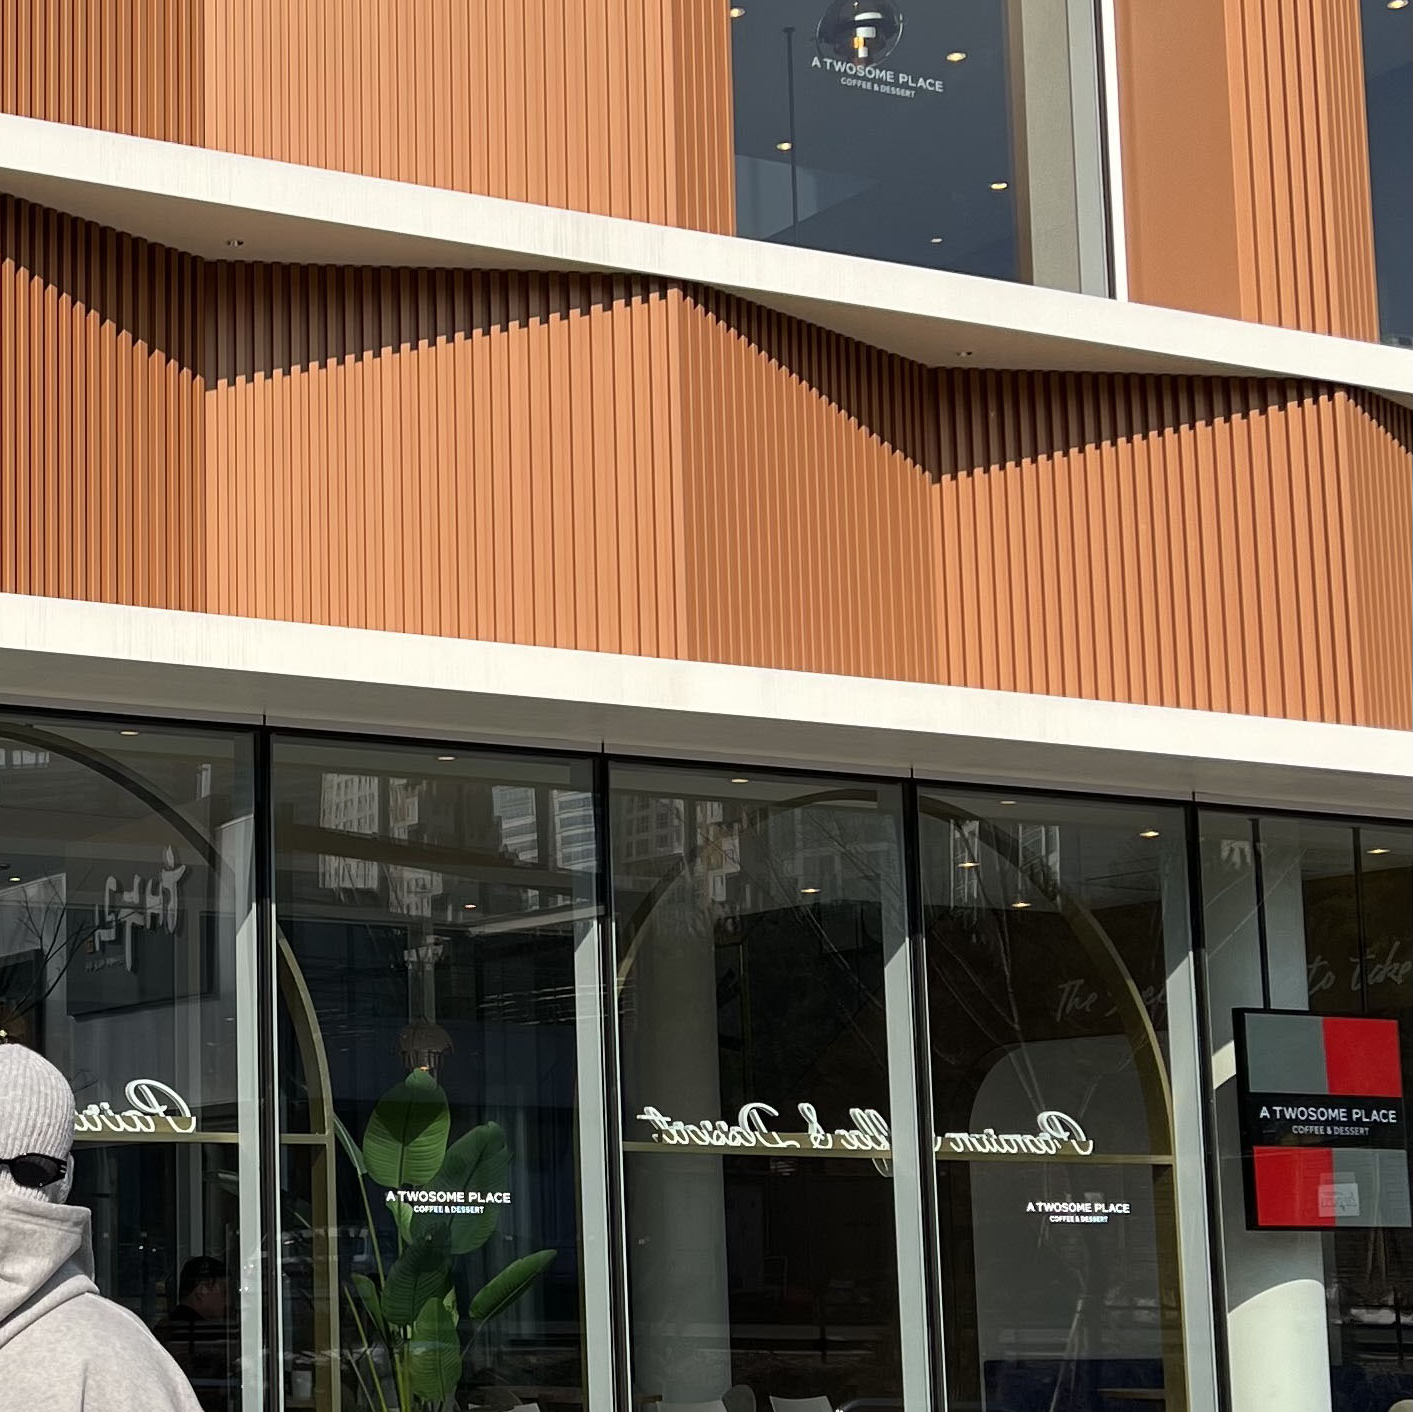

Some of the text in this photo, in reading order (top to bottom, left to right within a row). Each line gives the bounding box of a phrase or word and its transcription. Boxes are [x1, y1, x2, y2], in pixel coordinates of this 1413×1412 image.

[811, 56, 944, 93] A TWOSOME PLACE
[840, 77, 872, 91] COFFEE
[880, 84, 916, 98] DESSERT
[1259, 1106, 1397, 1123] A TWOSOME PLACE
[1291, 1125, 1325, 1135] COFFEE
[1333, 1126, 1369, 1136] DESSERT
[386, 1190, 511, 1204] A TWOSOME PLACE
[413, 1205, 443, 1213] COFFEE
[451, 1206, 485, 1214] DESSERT
[1026, 1201, 1131, 1214] A TWOSOME PLACE
[1049, 1215, 1074, 1223] COFFEE
[1080, 1215, 1108, 1223] DESSERT
